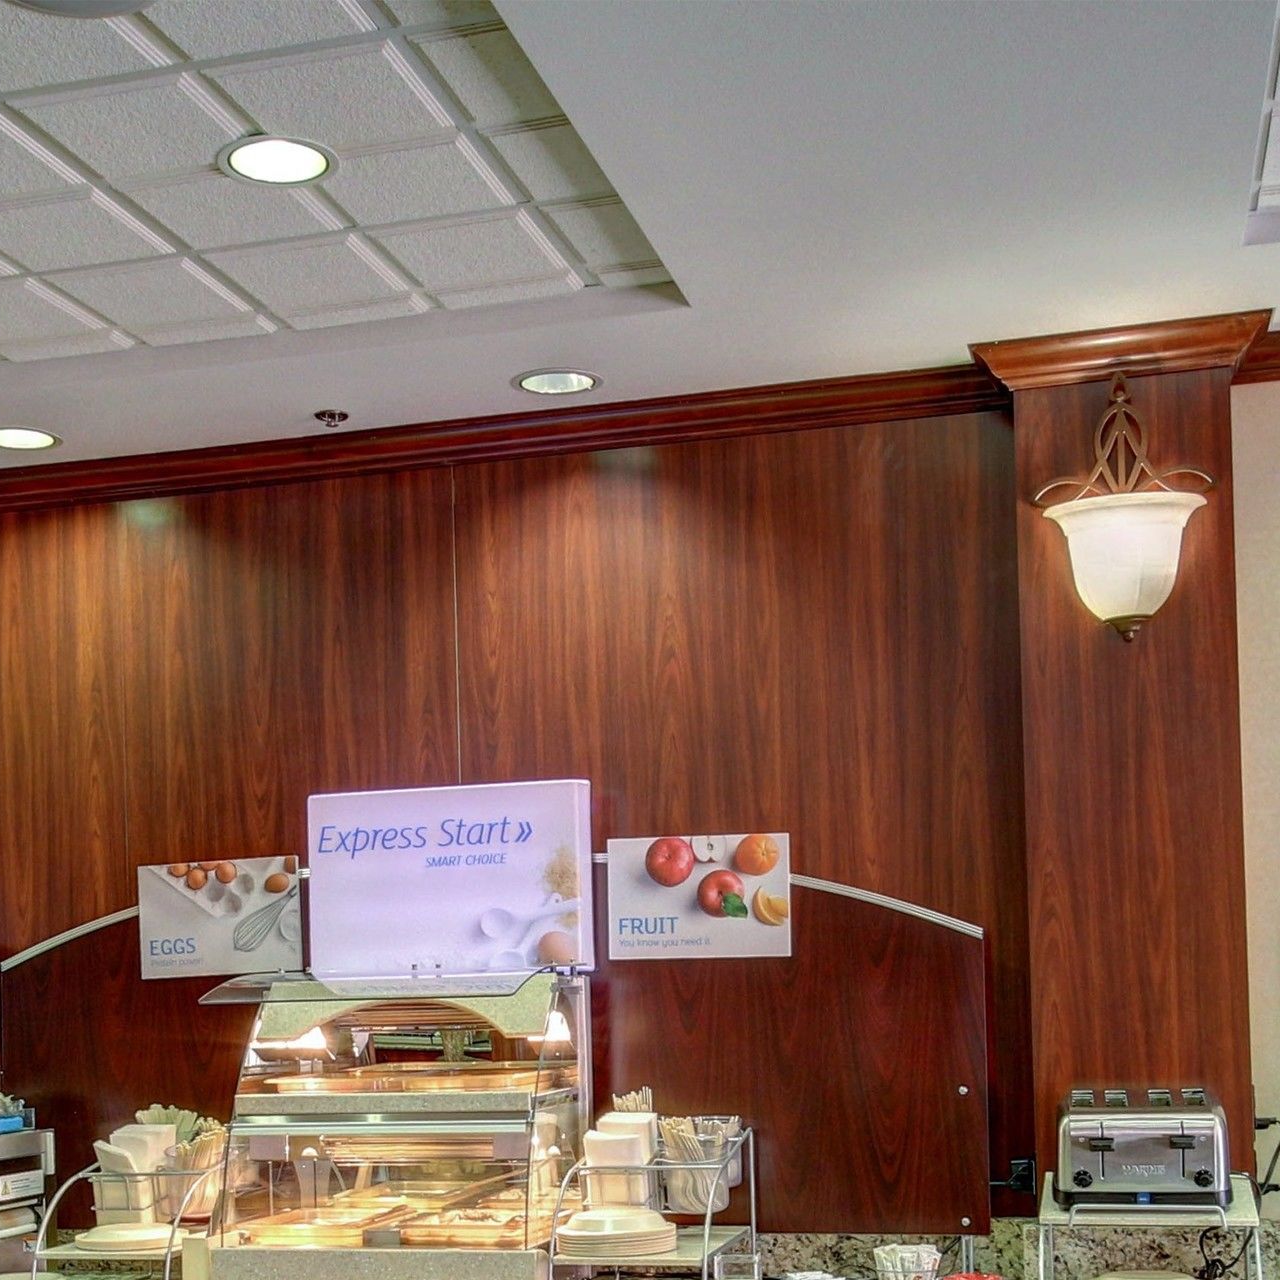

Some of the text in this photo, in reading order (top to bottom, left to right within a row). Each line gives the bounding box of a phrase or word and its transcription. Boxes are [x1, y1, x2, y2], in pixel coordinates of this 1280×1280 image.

[318, 816, 512, 859] Express Start
[424, 853, 508, 869] SMART CHOICE
[618, 917, 679, 935] FRUIT
[149, 937, 196, 956] EGGS
